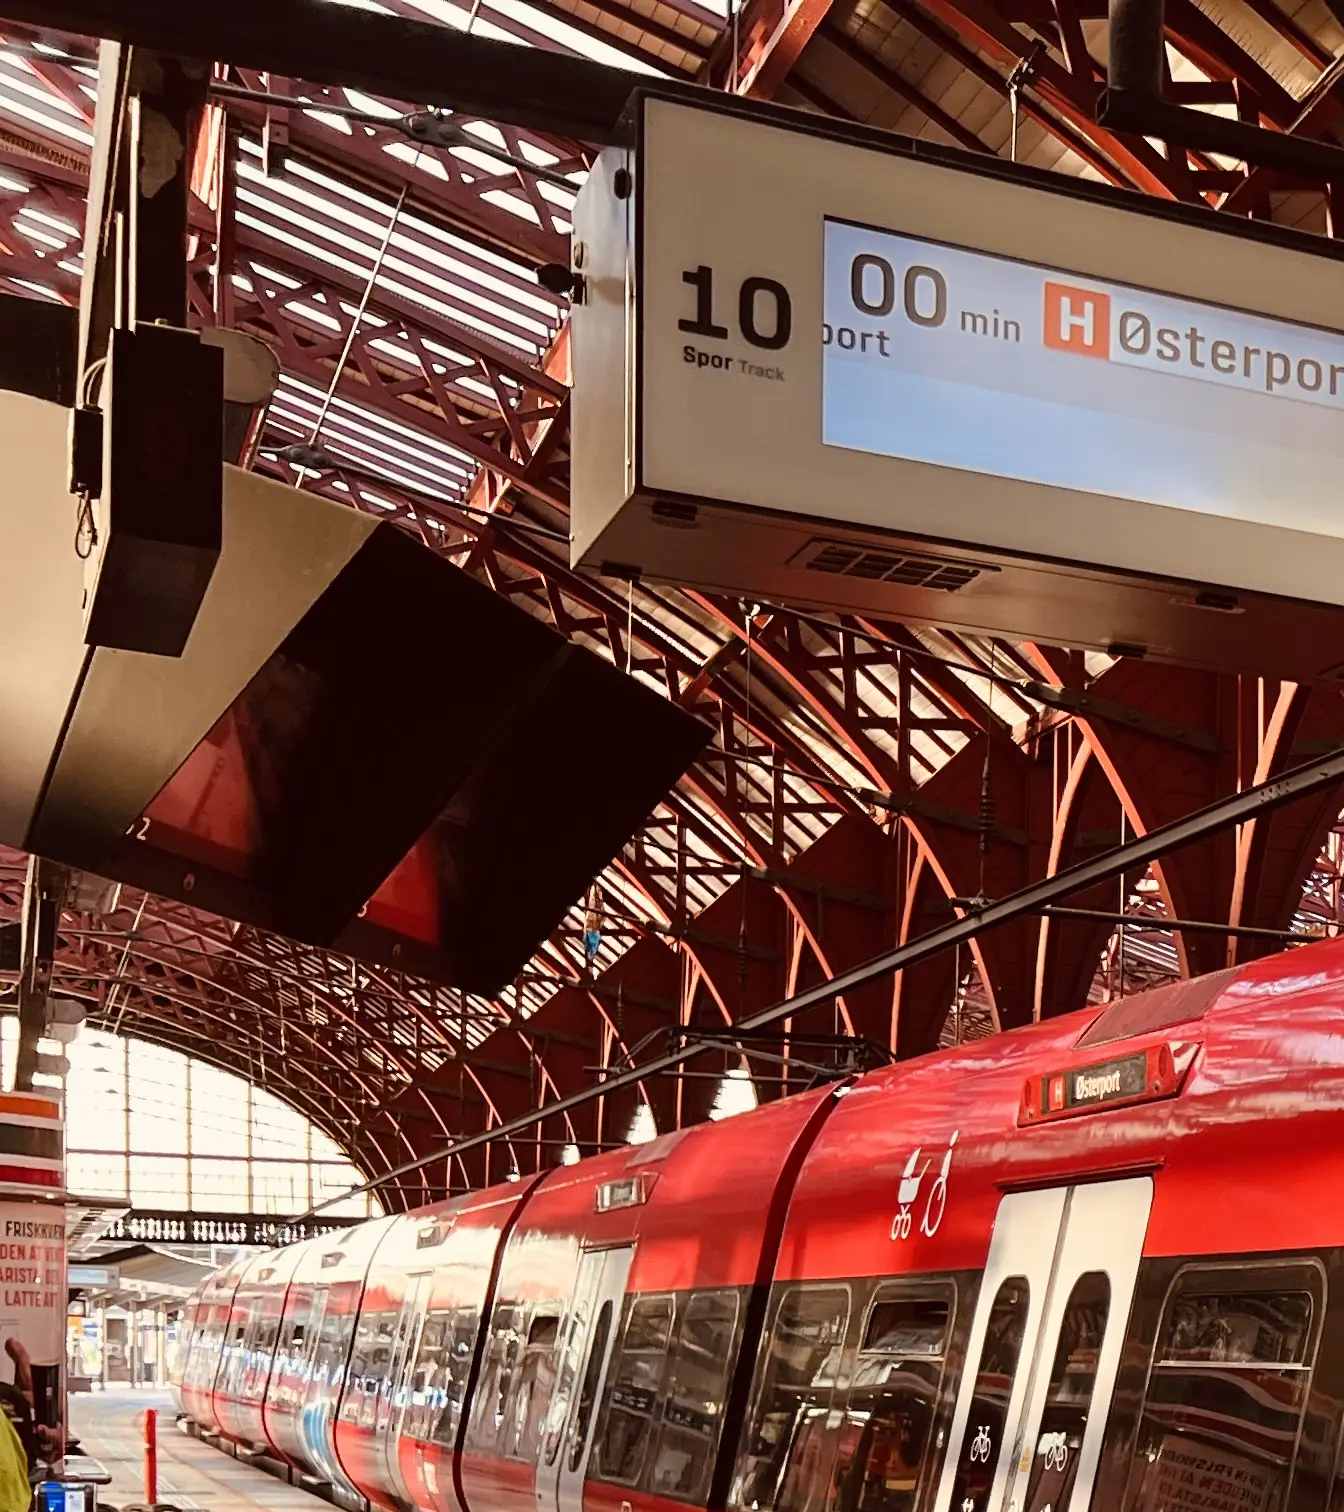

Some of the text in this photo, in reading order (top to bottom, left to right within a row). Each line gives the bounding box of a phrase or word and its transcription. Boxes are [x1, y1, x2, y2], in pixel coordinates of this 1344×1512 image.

[678, 265, 791, 350] 10
[851, 253, 947, 328] 00
[960, 308, 1021, 343] min
[1059, 295, 1095, 346] H
[683, 345, 785, 381] Spor Track
[1075, 1070, 1121, 1100] Østerport
